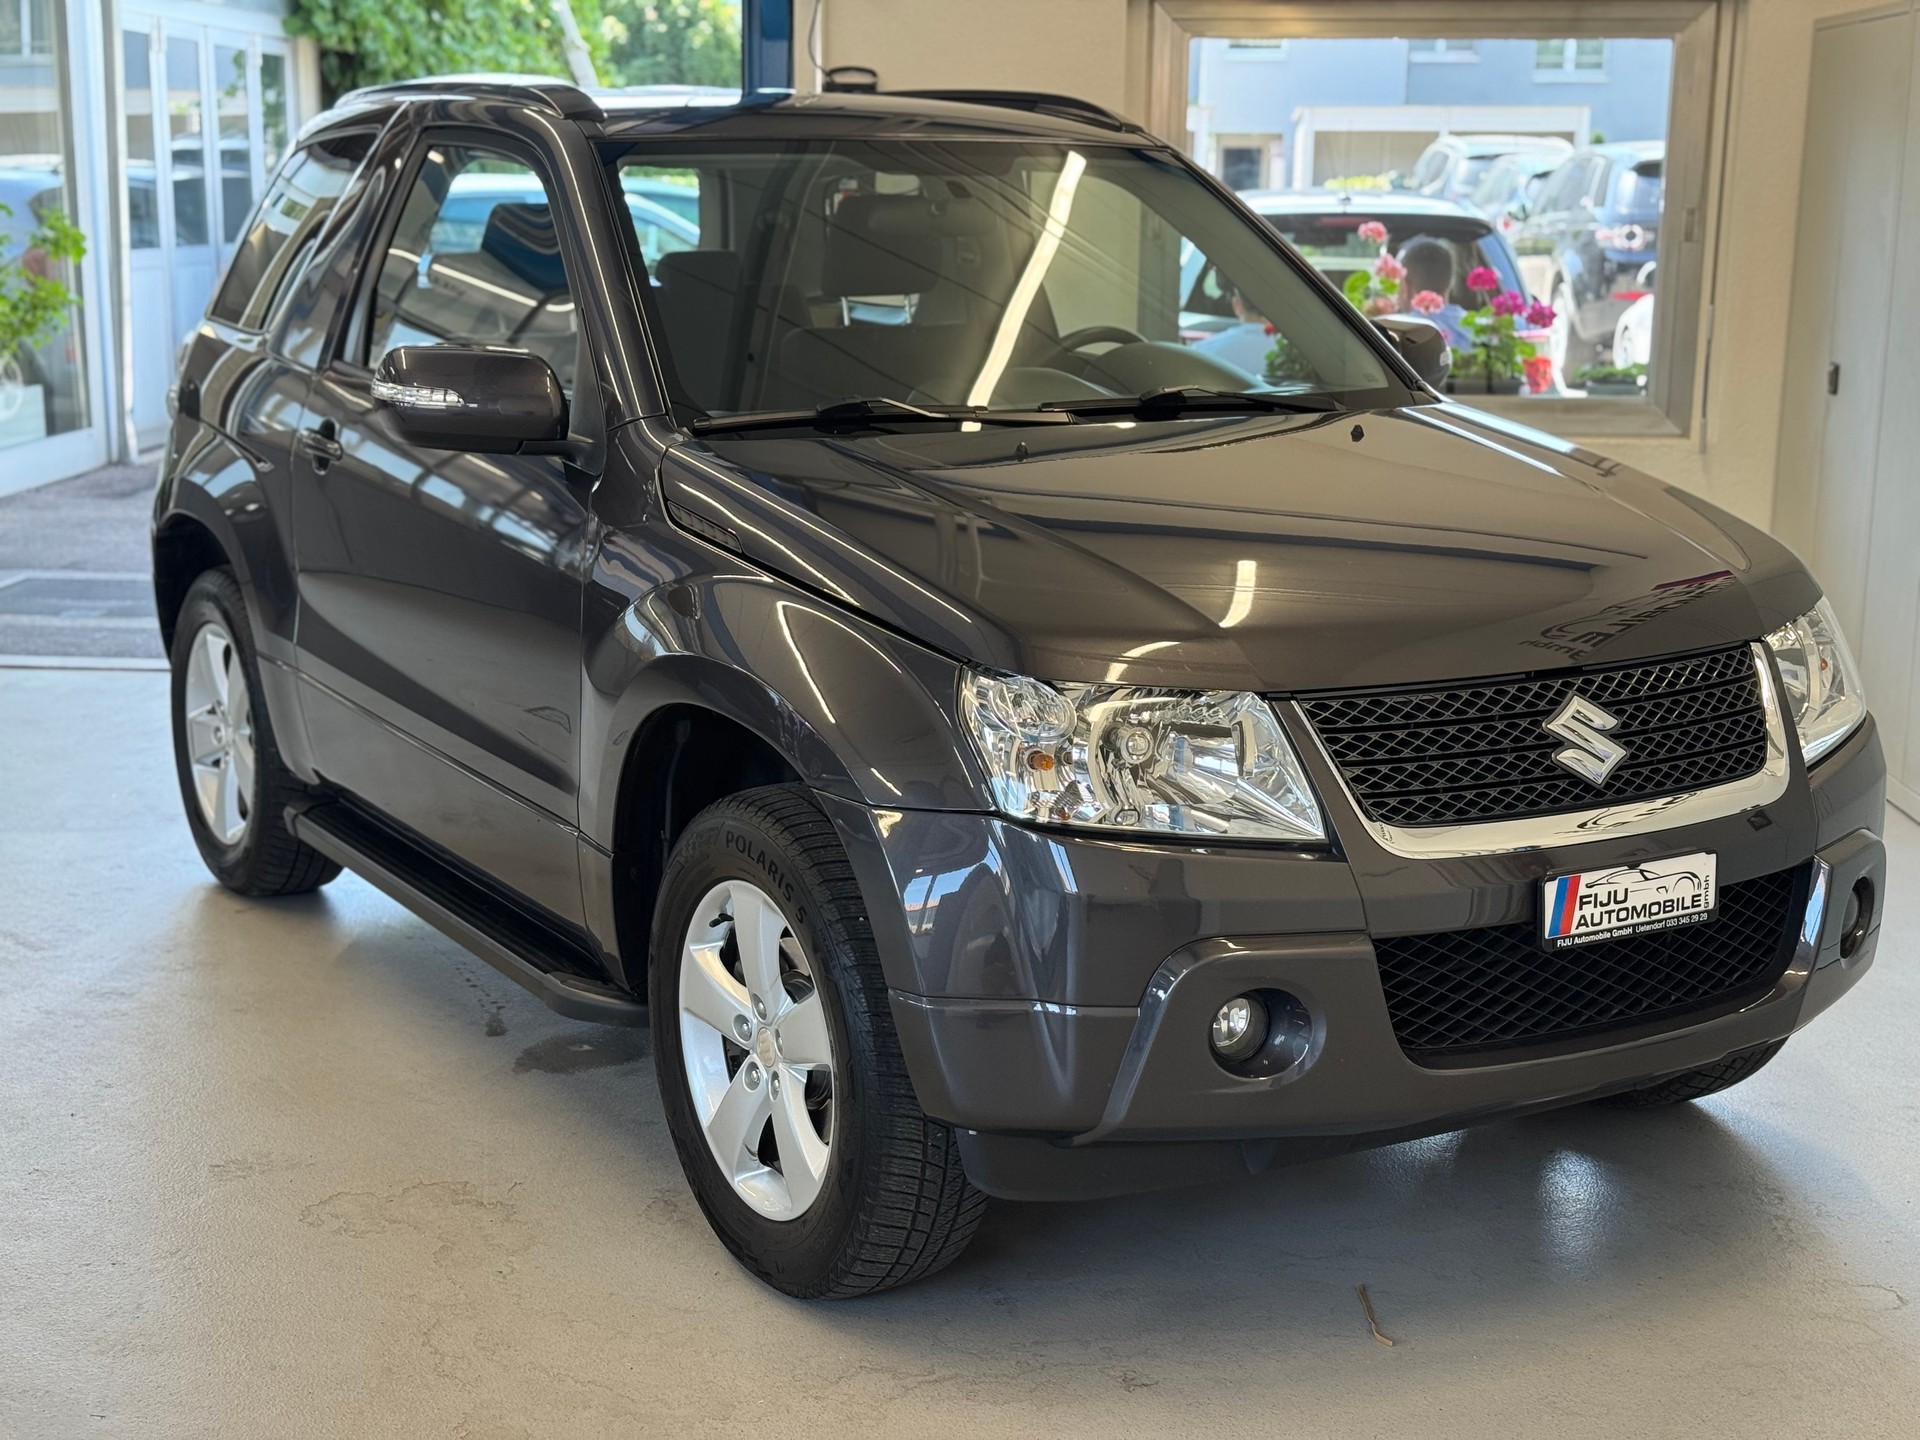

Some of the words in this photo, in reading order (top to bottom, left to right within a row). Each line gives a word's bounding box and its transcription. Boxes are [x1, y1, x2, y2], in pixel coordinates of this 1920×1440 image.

[725, 830, 794, 903] POLARIS
[795, 907, 808, 924] 5
[1574, 893, 1702, 931] AUTOMOBILE
[1578, 887, 1629, 911] FIJU
[1557, 937, 1573, 948] FIJU
[1573, 931, 1611, 945] Automobile
[1612, 926, 1633, 938] GmbH
[1635, 921, 1666, 933] Uetendorf
[1666, 918, 1677, 927] 033
[1679, 915, 1690, 925] 345
[1691, 914, 1699, 923] 29
[1700, 912, 1708, 921] 29
